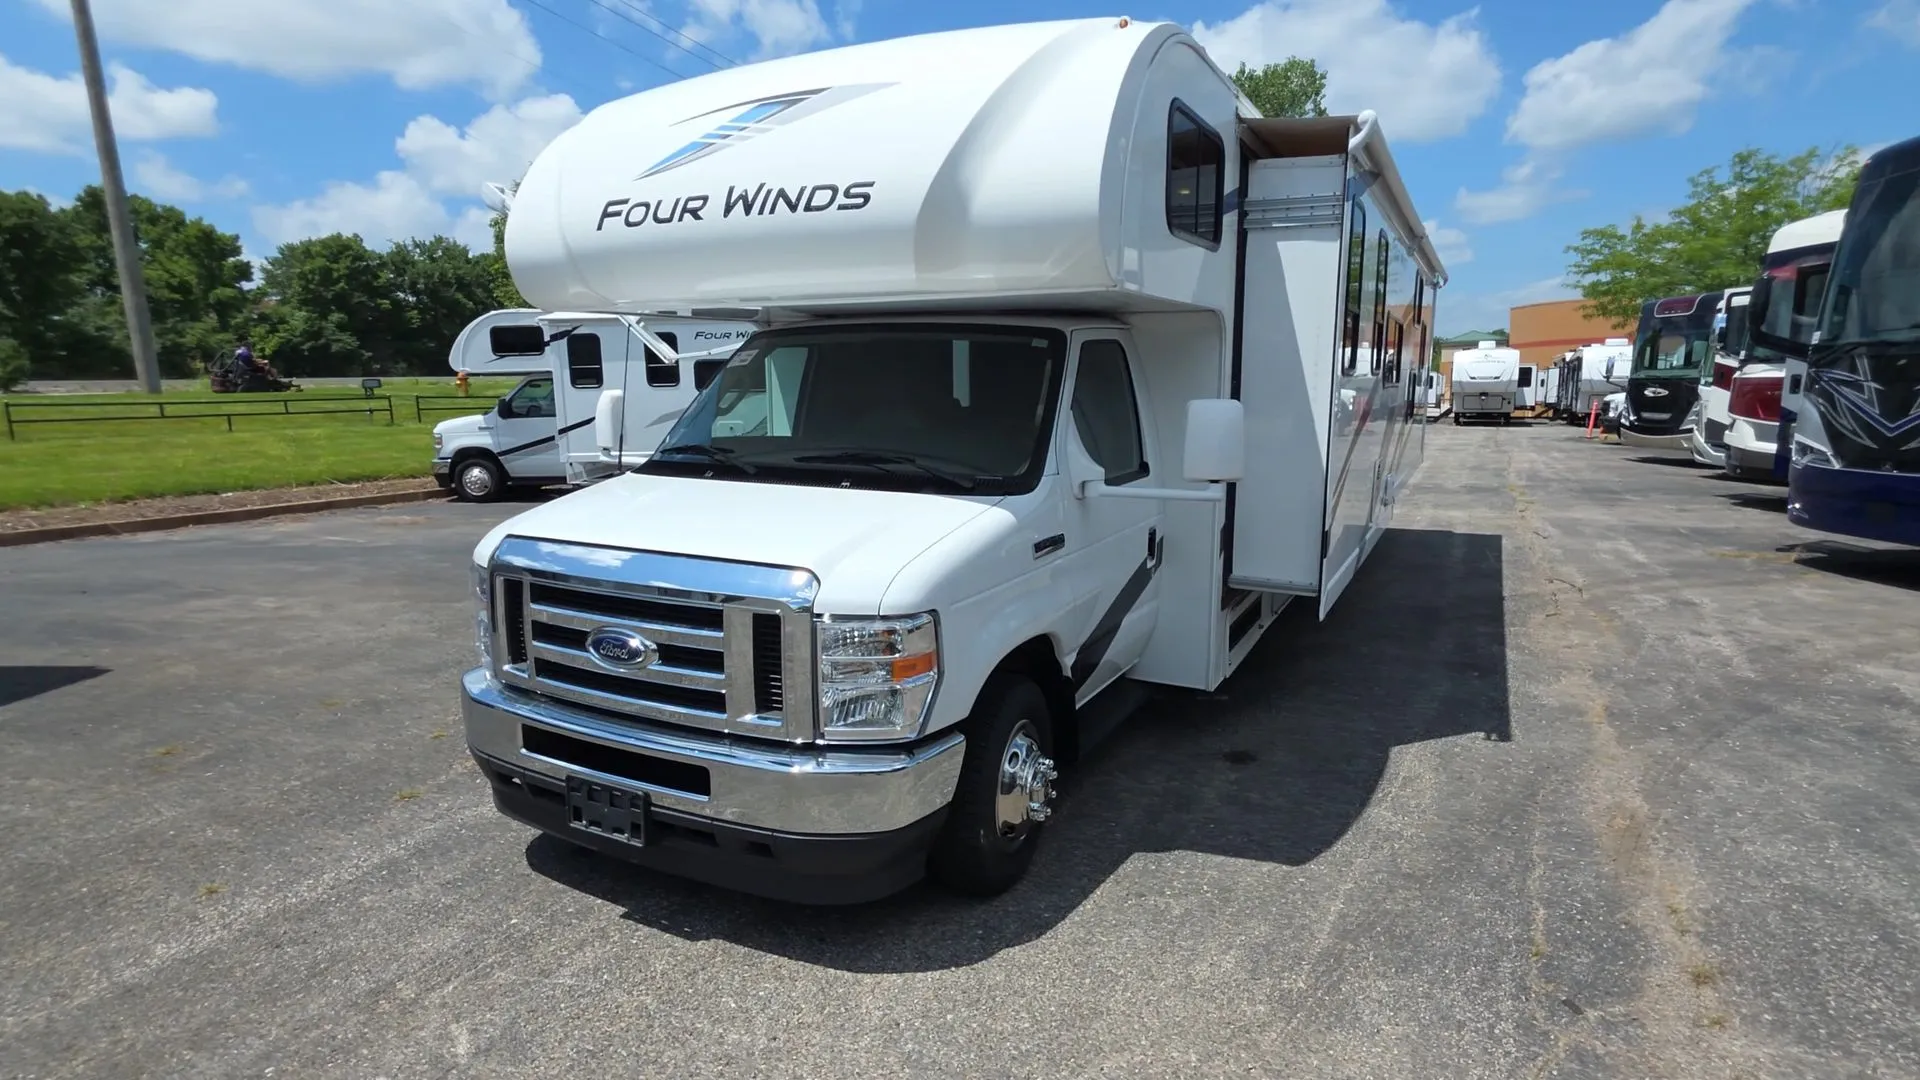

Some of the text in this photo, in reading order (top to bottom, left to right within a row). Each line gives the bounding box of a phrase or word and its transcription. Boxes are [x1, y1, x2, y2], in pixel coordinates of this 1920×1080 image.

[596, 181, 876, 231] FOUR WINDS
[694, 331, 732, 340] FOUR
[600, 639, 630, 659] Ford
